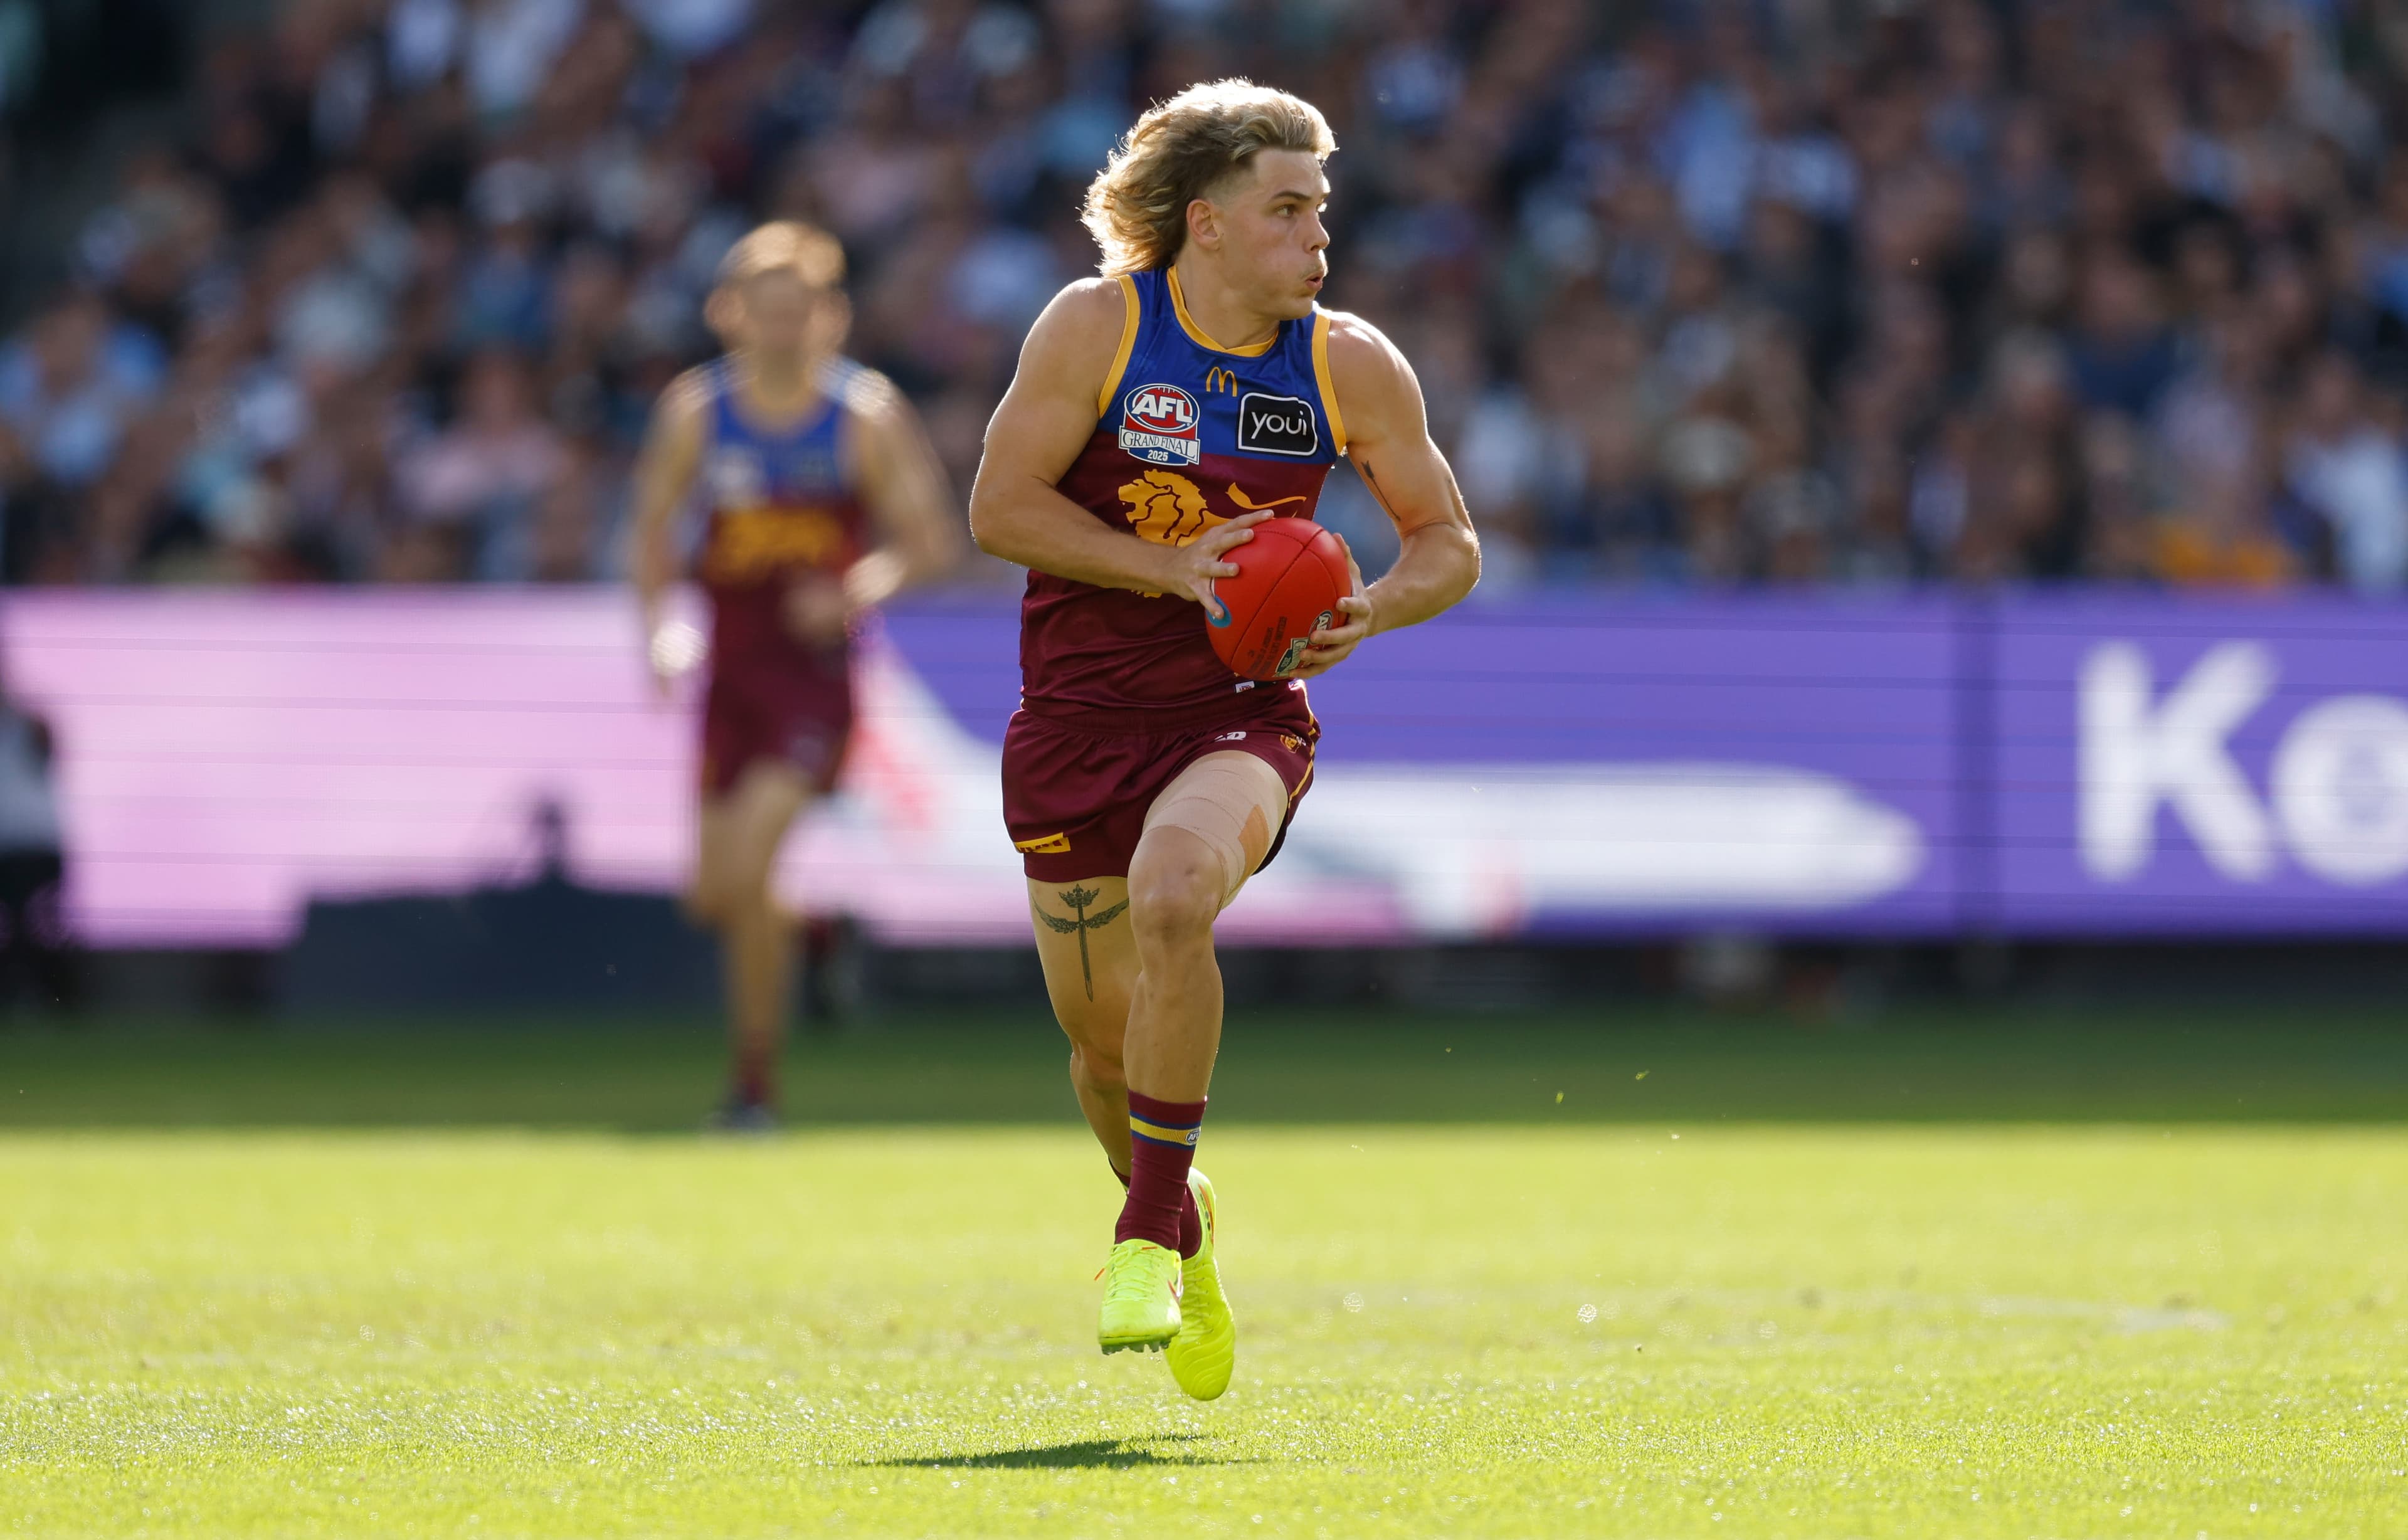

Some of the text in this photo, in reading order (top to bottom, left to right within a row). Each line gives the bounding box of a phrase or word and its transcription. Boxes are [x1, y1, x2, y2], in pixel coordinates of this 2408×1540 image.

[1131, 393, 1193, 423] AFL
[1251, 410, 1307, 440] youi
[1122, 431, 1195, 459] GRAND FINAL
[1147, 450, 1168, 461] 2025
